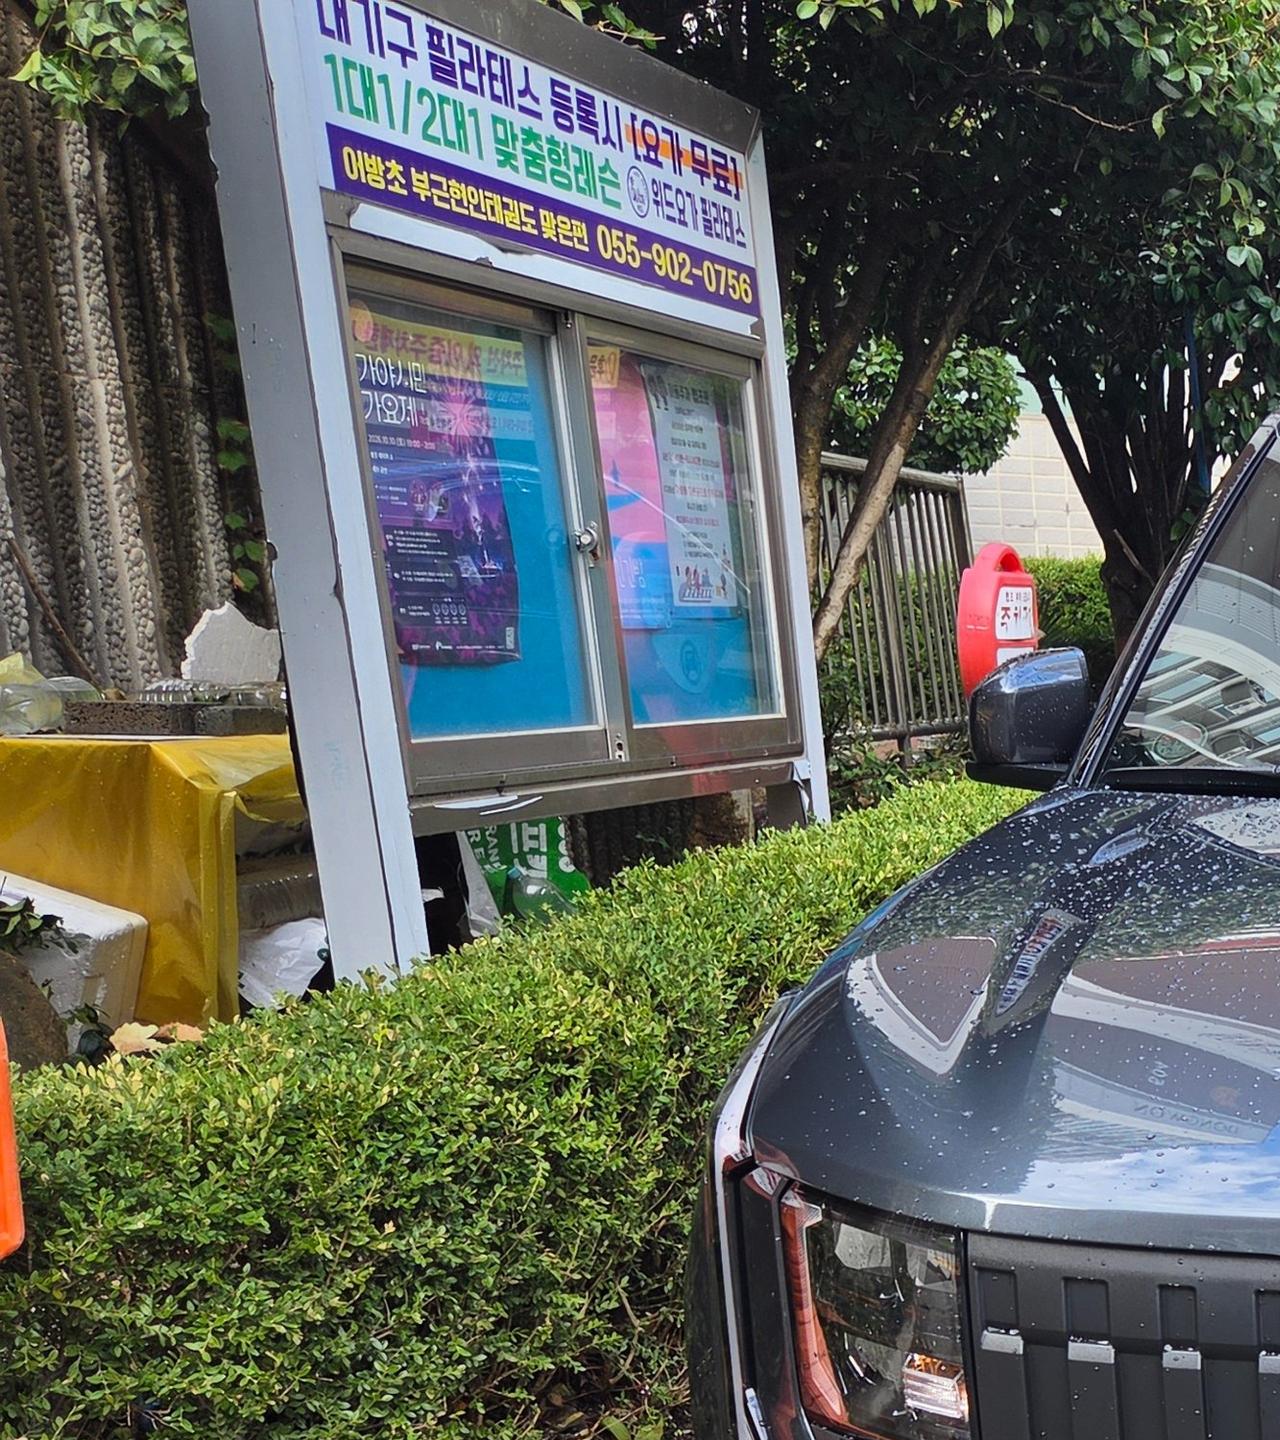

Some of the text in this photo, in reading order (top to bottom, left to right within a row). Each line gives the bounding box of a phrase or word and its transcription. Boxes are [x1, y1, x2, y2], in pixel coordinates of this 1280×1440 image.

[425, 23, 543, 121] 필라테스
[549, 76, 624, 153] 등록시
[491, 113, 622, 210] 맞춤형레슨
[342, 146, 408, 197] 어방초
[539, 206, 590, 252] 맞은편
[596, 224, 753, 304] 055-902-0756
[651, 177, 699, 232] 위드요가
[700, 196, 747, 249] 필라테스
[355, 354, 428, 393] 가야시민
[360, 390, 419, 427] 가요제
